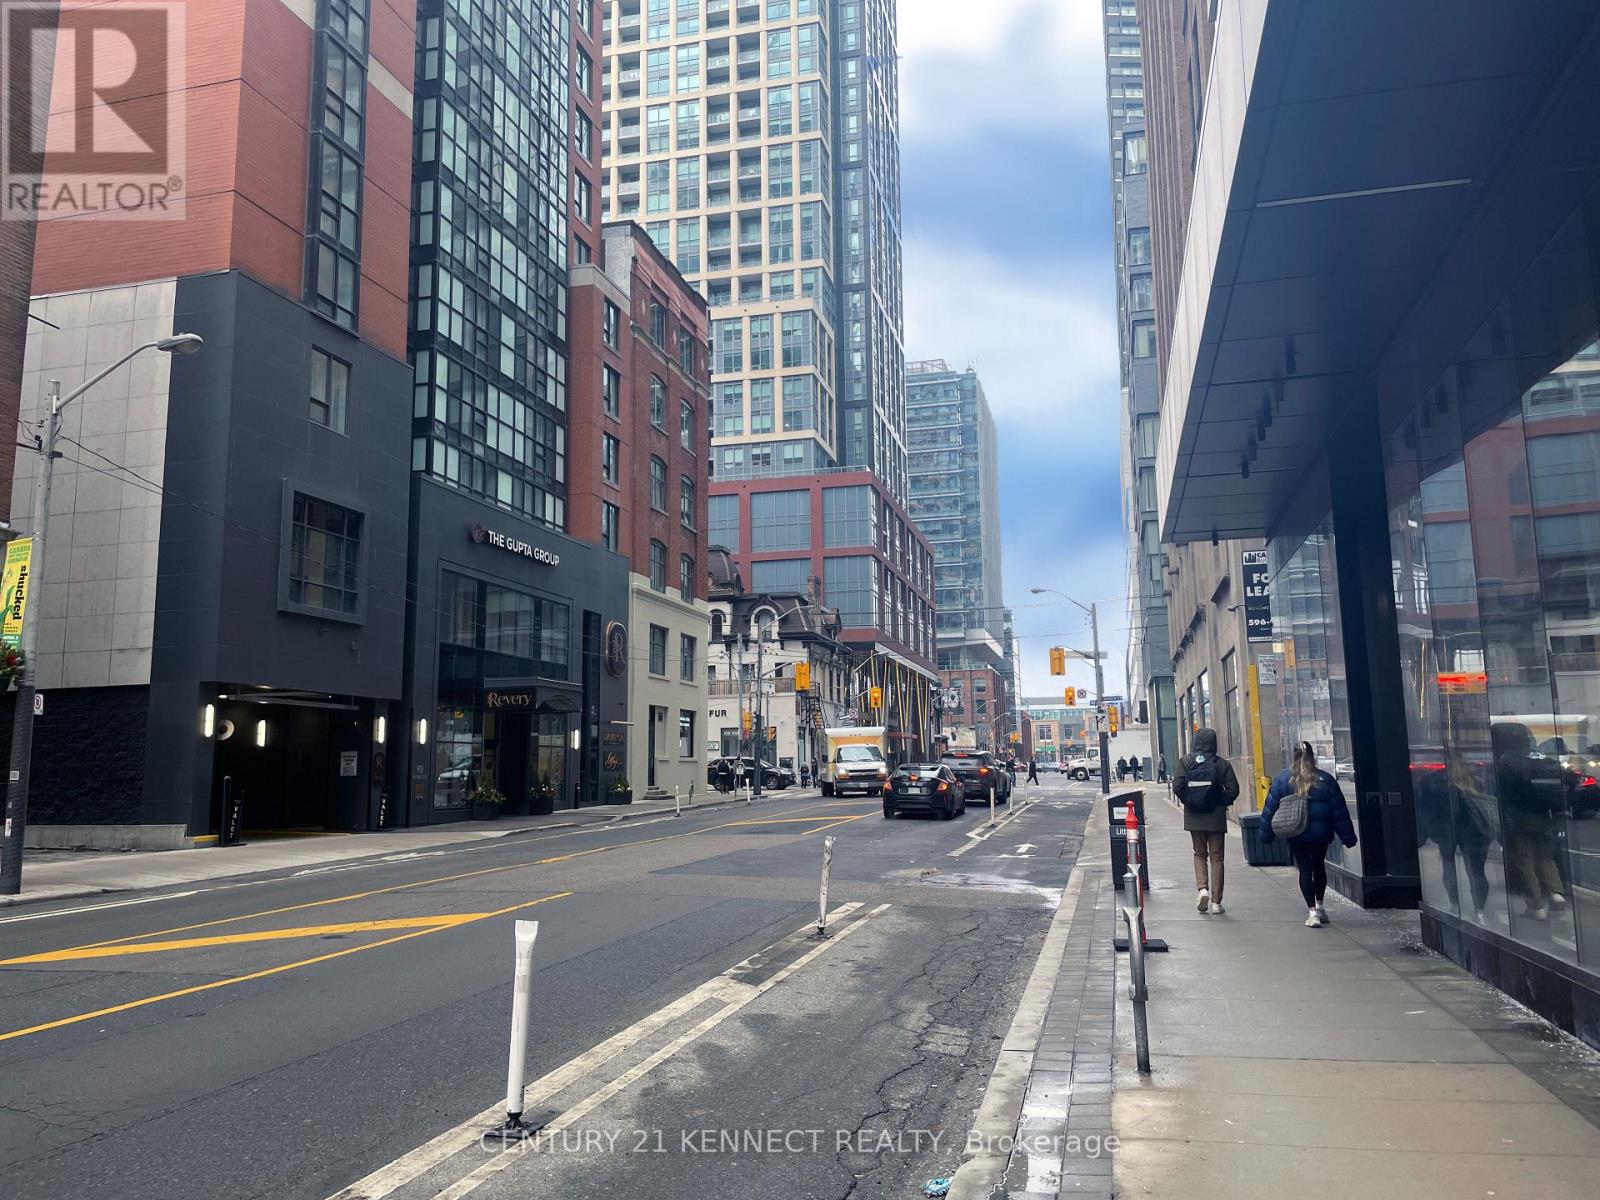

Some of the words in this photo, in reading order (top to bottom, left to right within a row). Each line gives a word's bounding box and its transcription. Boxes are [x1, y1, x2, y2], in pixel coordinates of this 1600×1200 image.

[488, 530, 505, 548] THE
[506, 537, 533, 558] GUPTA
[533, 547, 560, 567] GROUP
[1252, 572, 1270, 584] FO
[13, 565, 28, 621] shucked
[1246, 585, 1271, 597] LEA
[1248, 619, 1272, 627] 596-
[487, 692, 532, 708] Revery
[709, 709, 727, 718] FUR
[379, 798, 387, 827] VALET
[230, 805, 240, 839] VALET
